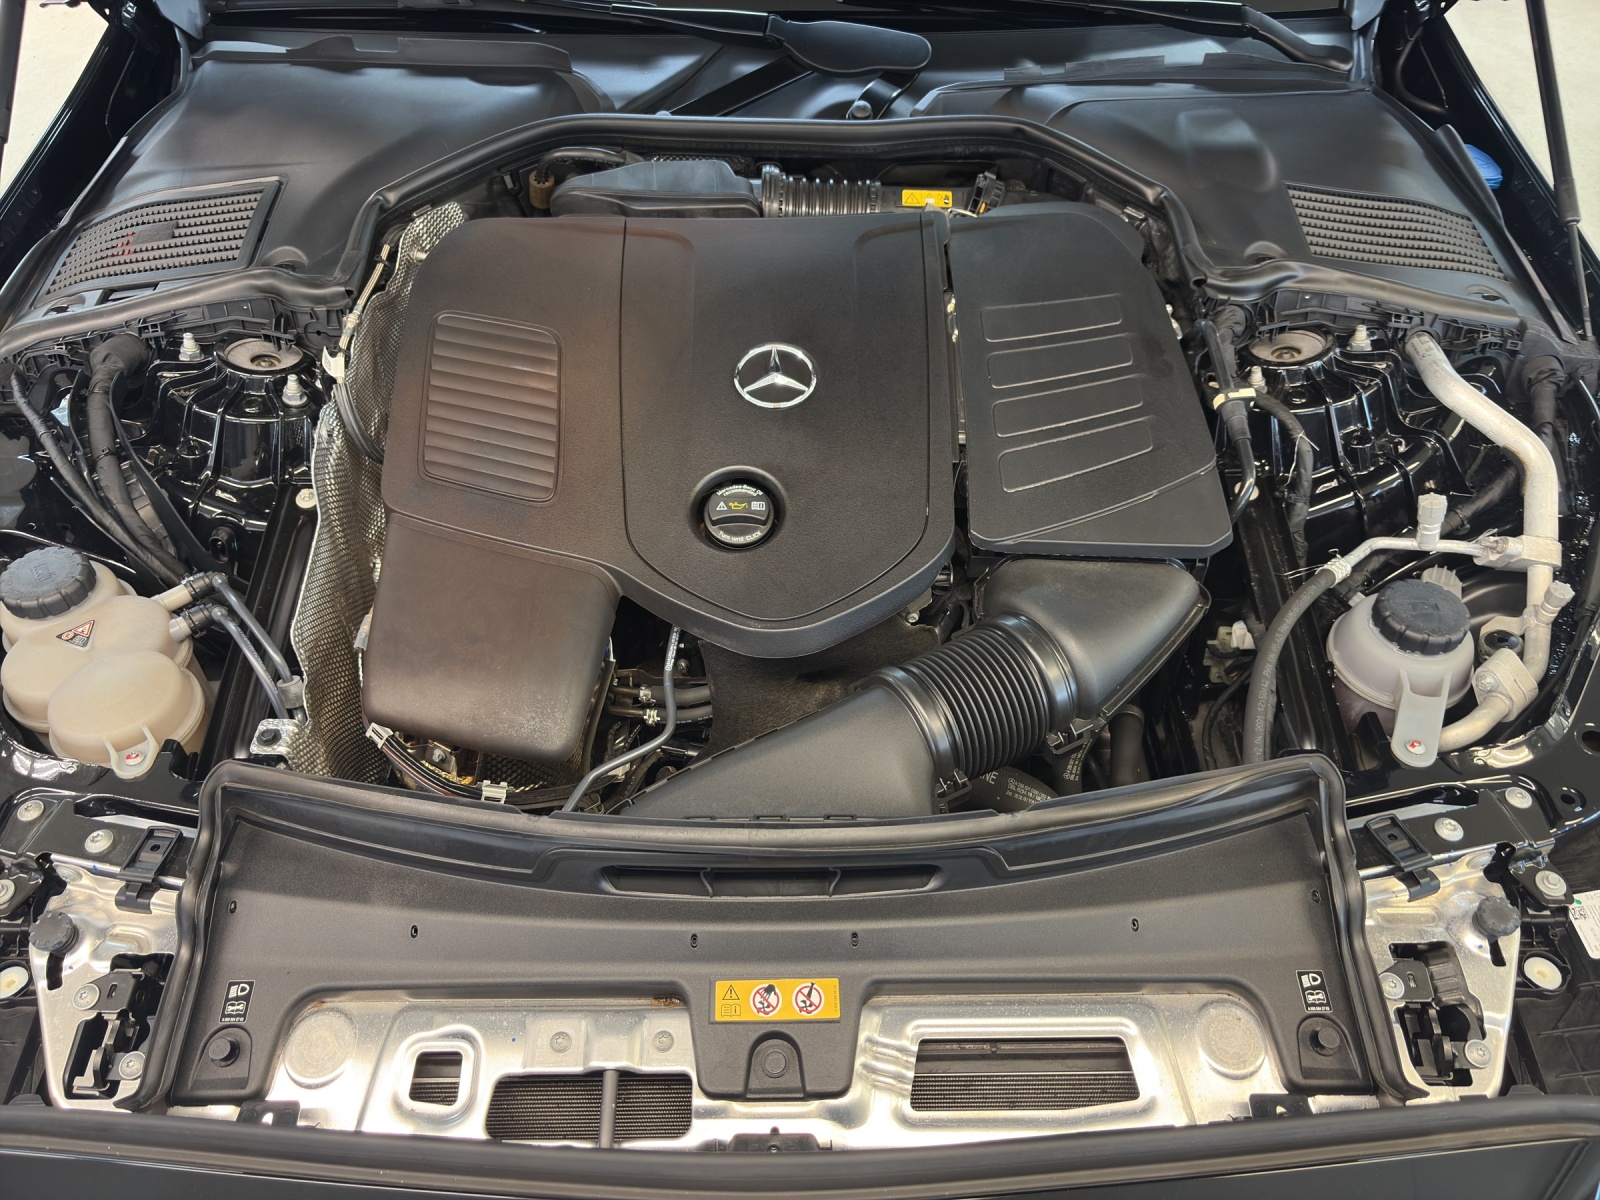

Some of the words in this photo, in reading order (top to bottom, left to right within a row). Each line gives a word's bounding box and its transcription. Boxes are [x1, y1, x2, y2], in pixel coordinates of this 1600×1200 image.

[718, 530, 731, 540] Turn
[745, 530, 762, 541] CLICK
[1257, 678, 1269, 712] 12:50:42
[1254, 715, 1264, 756] 12.04.2021
[979, 771, 999, 785] NE
